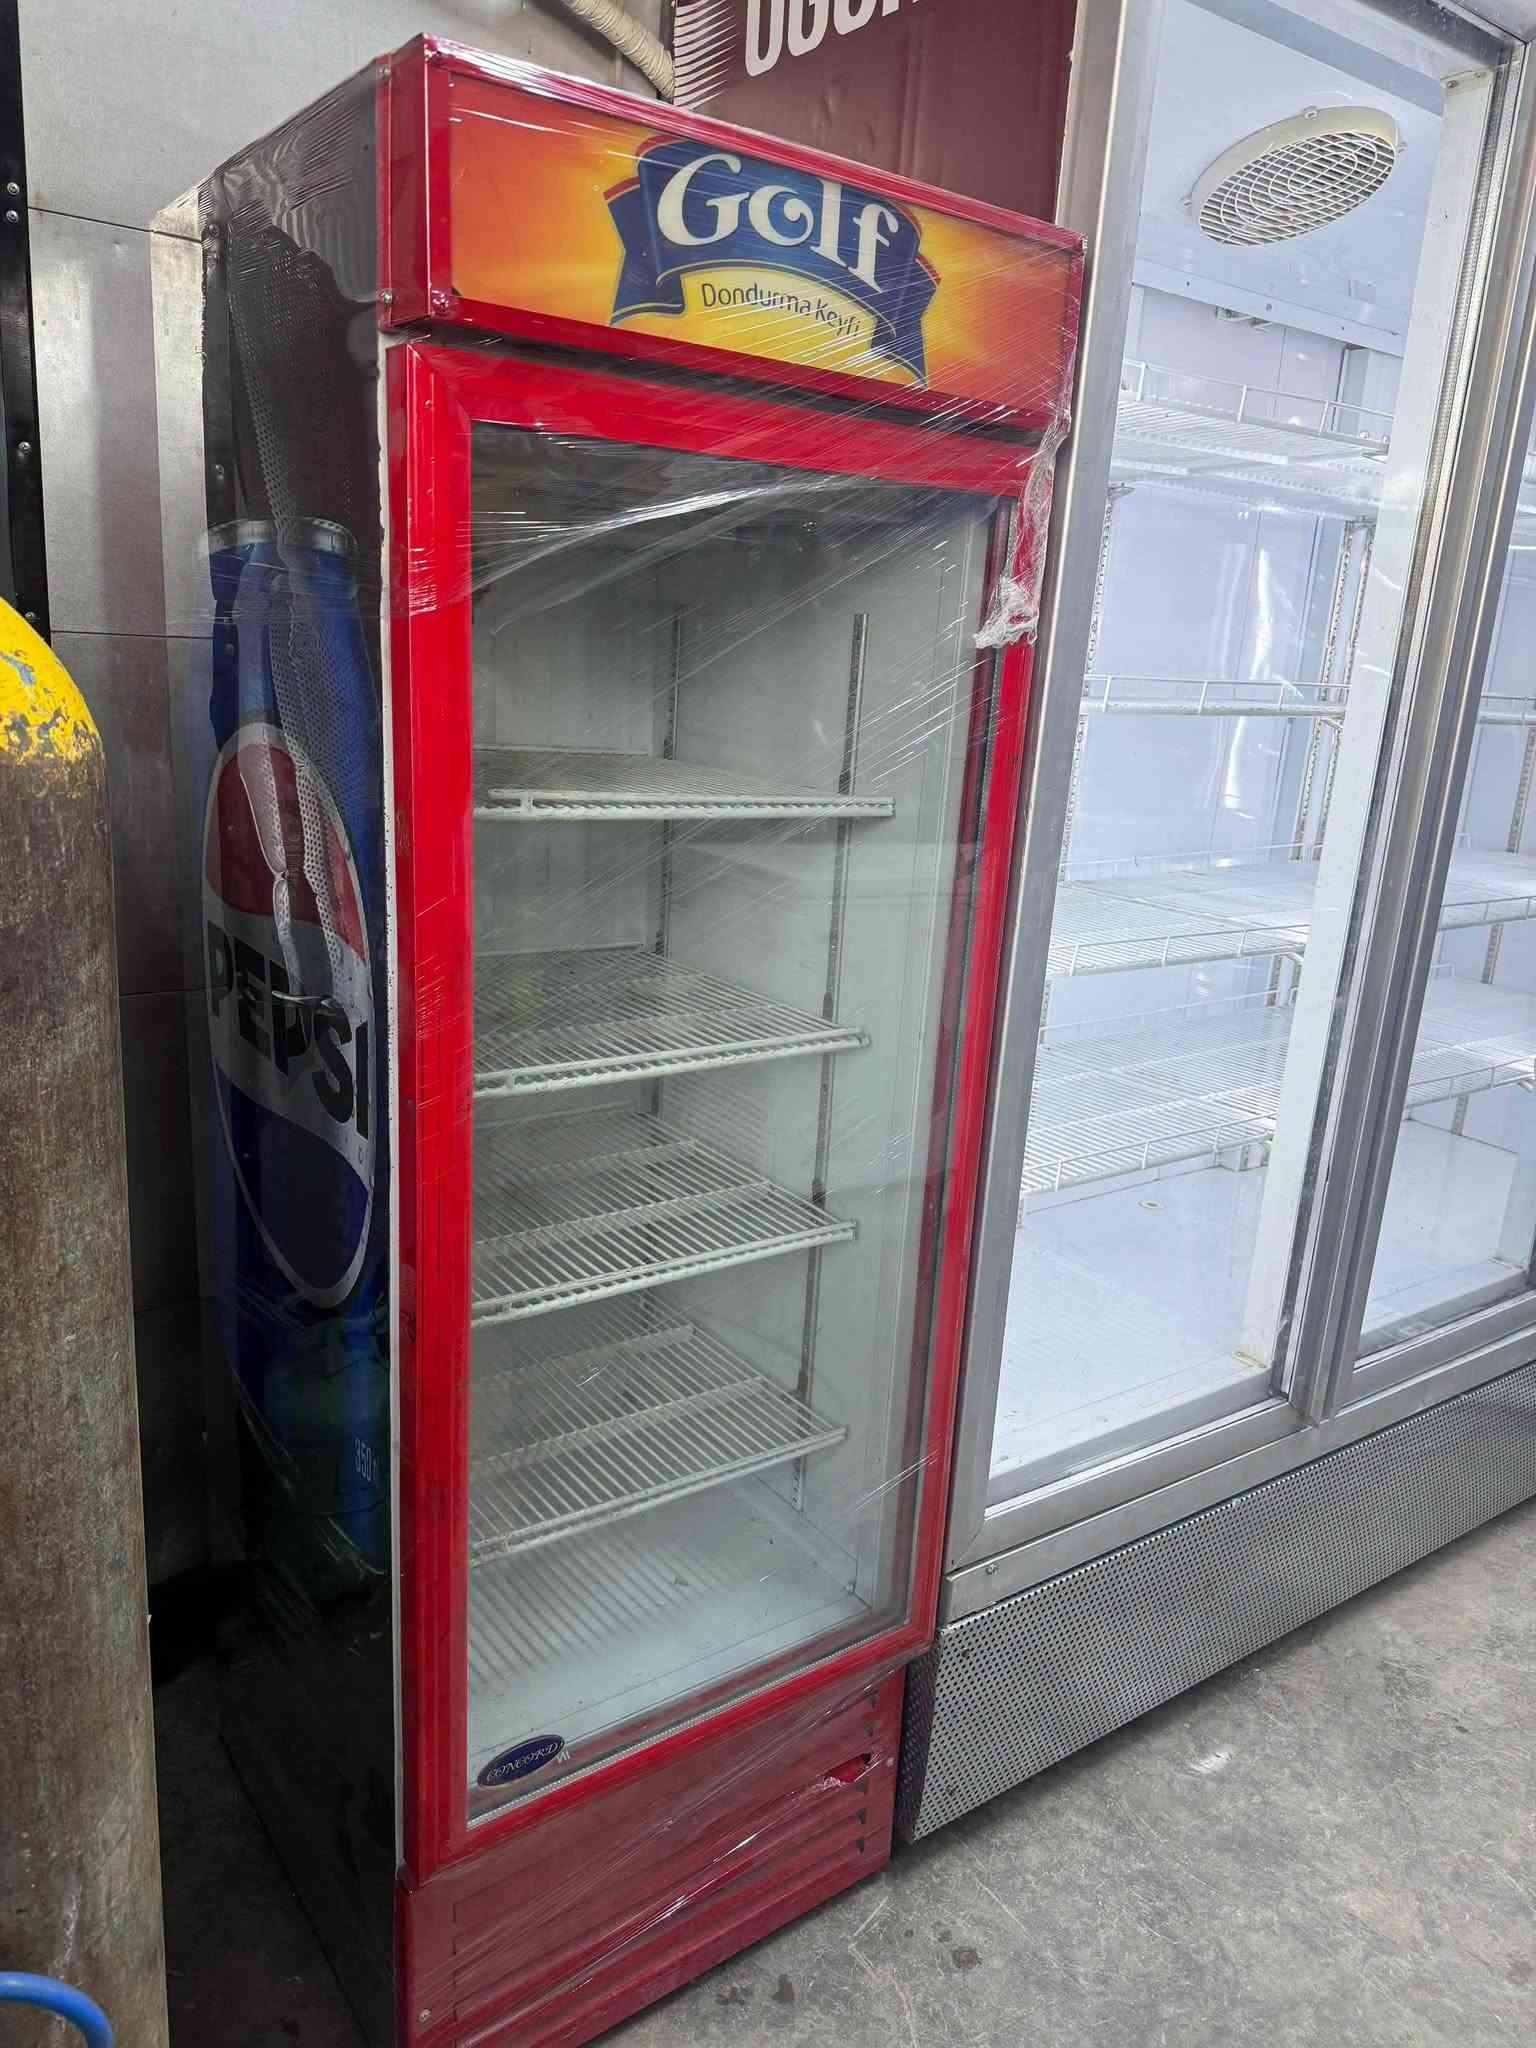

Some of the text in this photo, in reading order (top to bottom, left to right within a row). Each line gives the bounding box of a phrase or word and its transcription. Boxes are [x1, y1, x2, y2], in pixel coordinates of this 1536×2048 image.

[745, 0, 919, 77] UG
[657, 153, 899, 293] Golf
[701, 282, 861, 338] Dondurma Keyfi
[208, 921, 369, 1141] PEPSI
